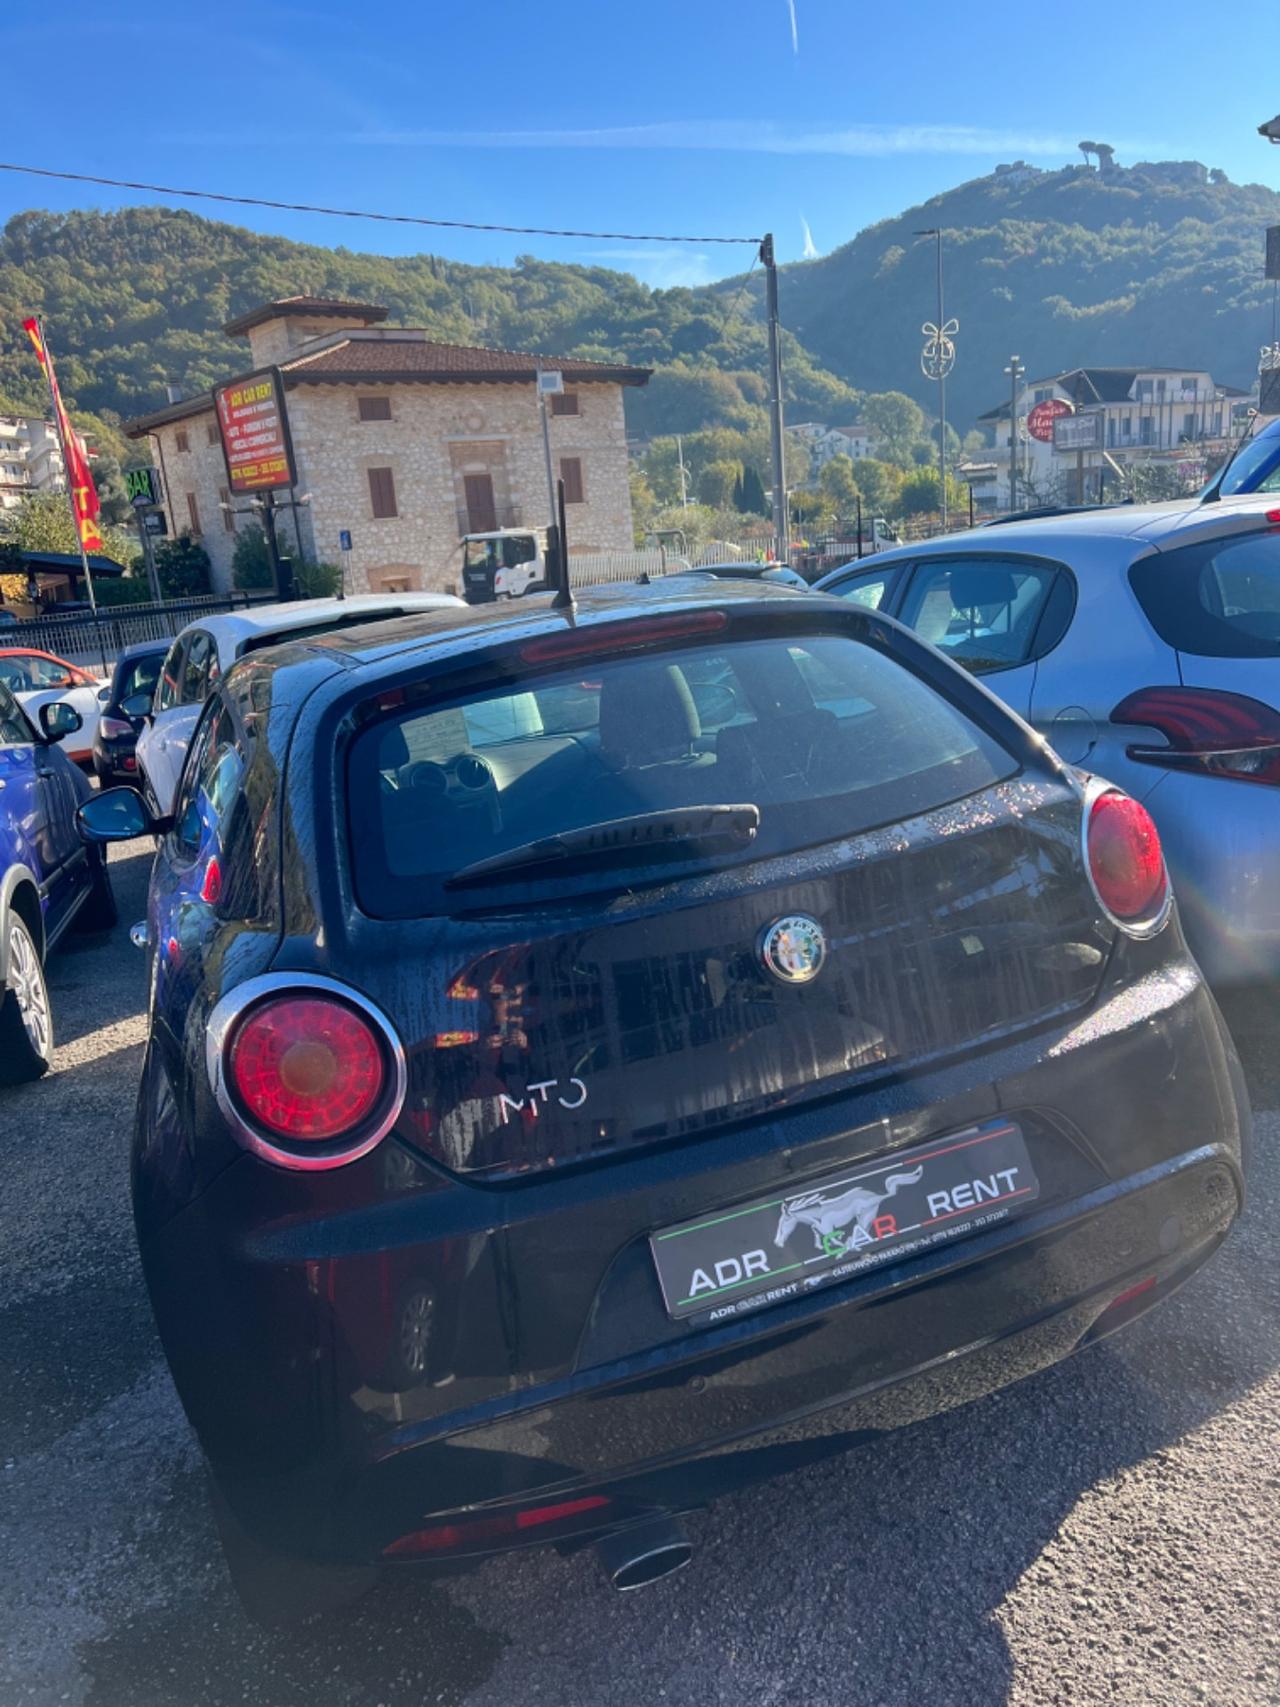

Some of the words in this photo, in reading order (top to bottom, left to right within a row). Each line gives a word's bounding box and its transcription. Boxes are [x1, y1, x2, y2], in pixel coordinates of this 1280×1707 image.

[125, 469, 152, 502] BAR
[688, 1248, 770, 1296] ADR
[824, 1214, 898, 1257] CAR
[927, 1168, 1019, 1217] RENT
[709, 1303, 736, 1320] ADR
[766, 1283, 798, 1301] RENT
